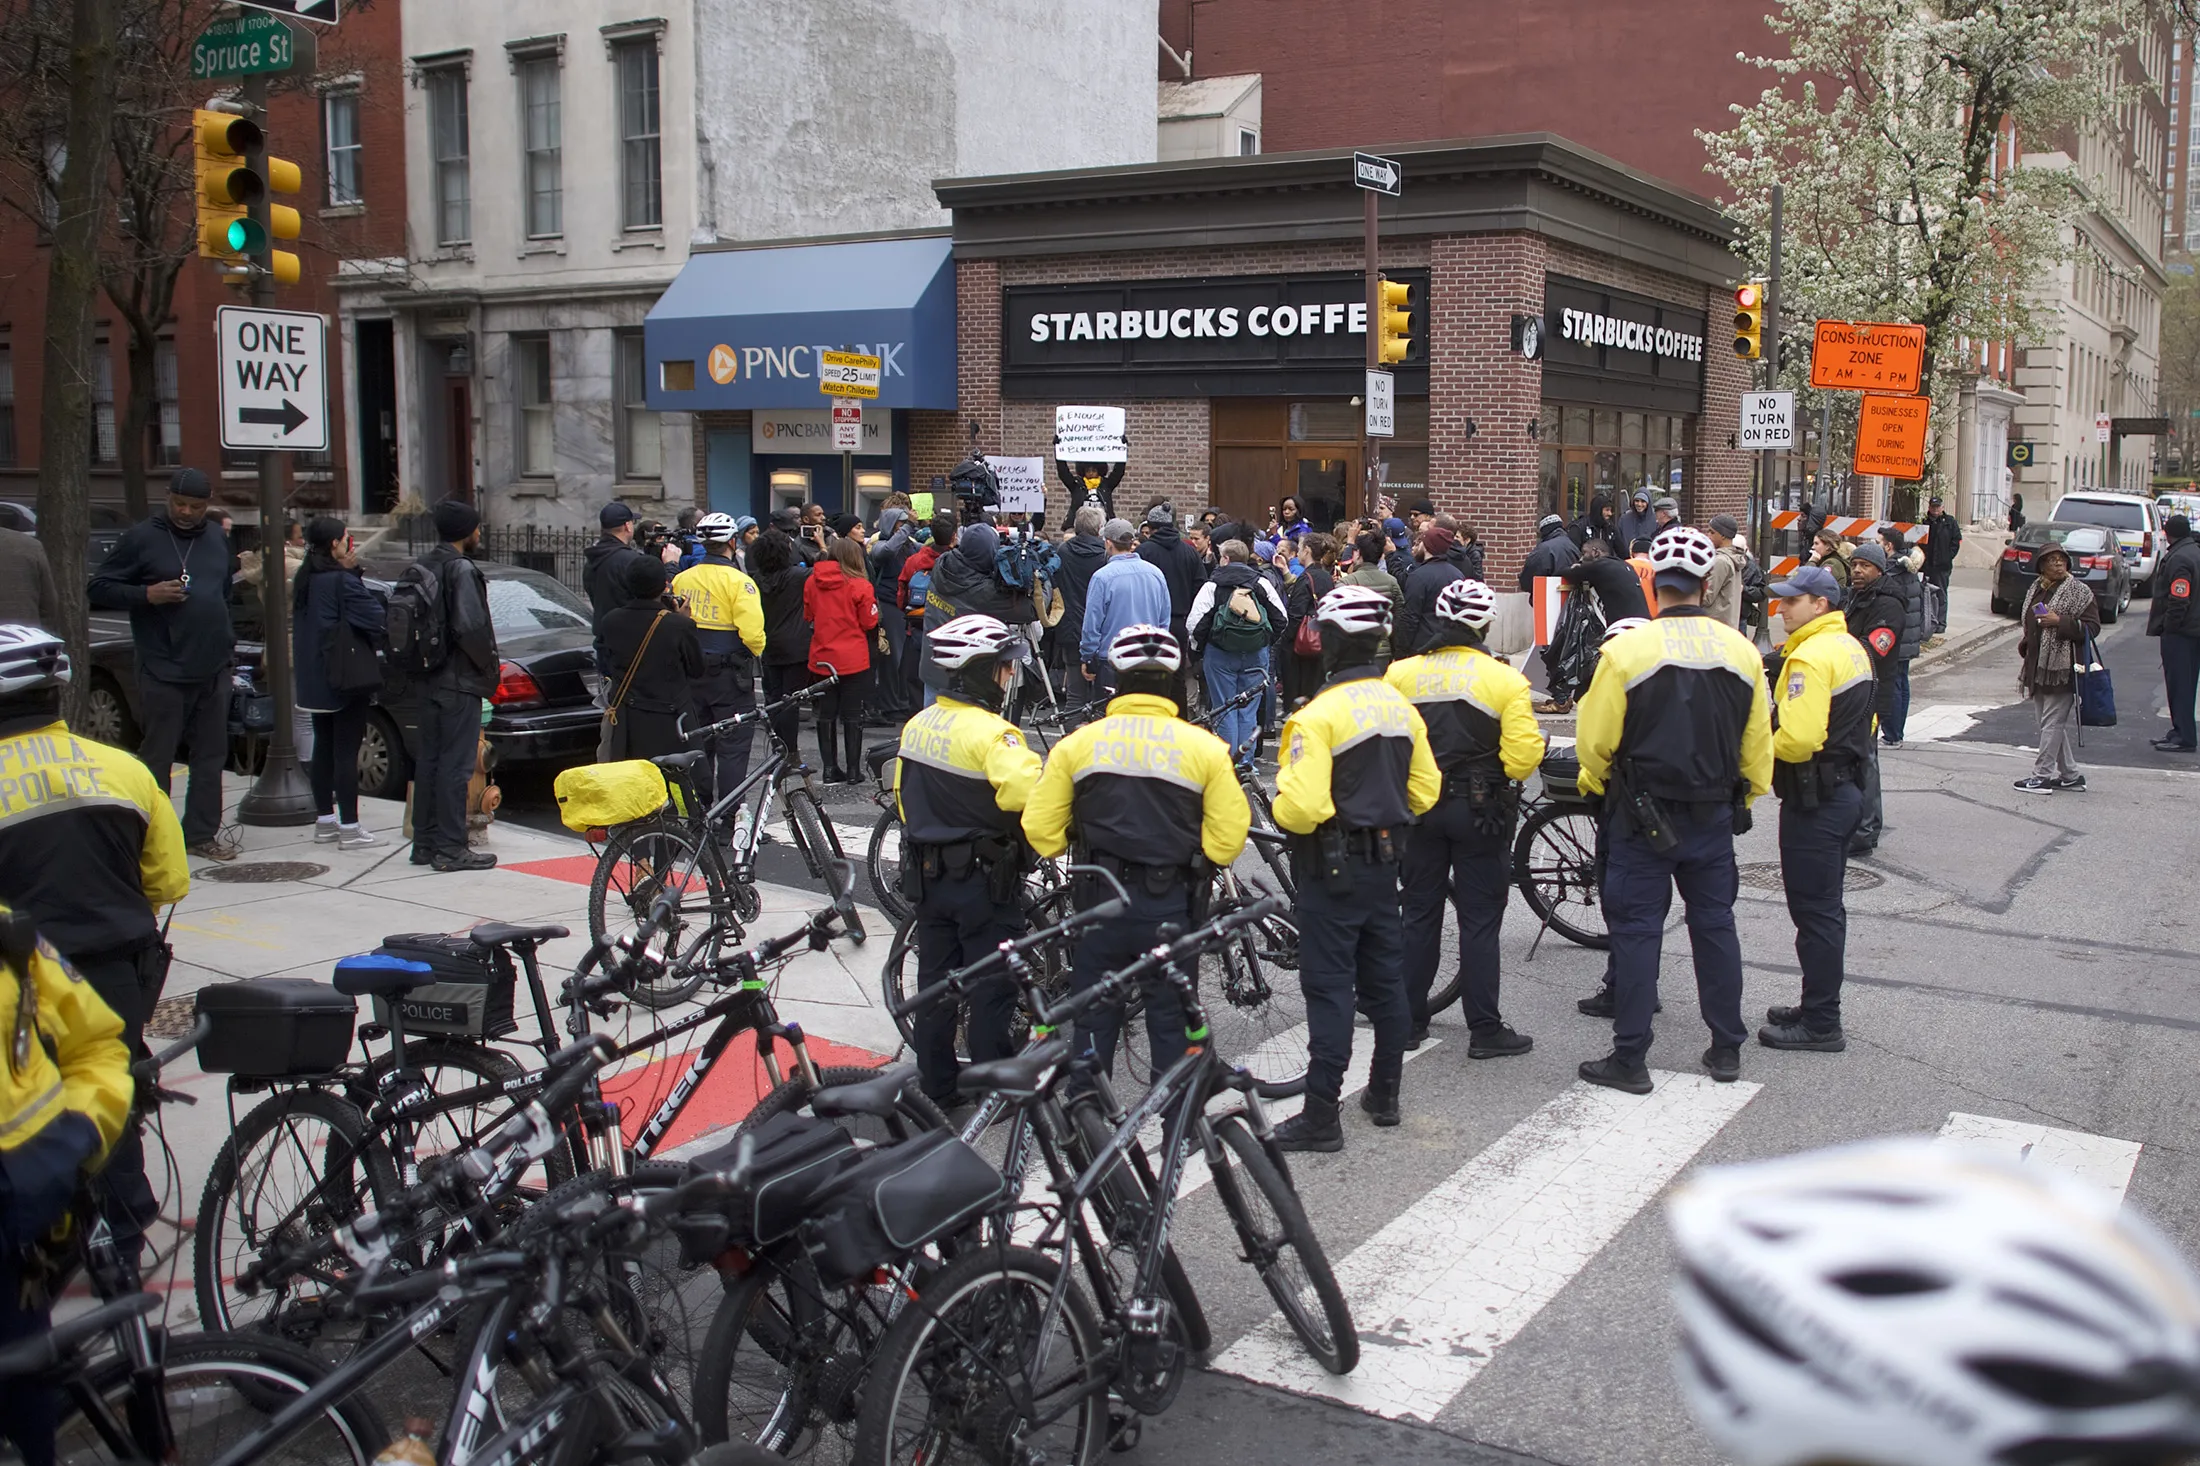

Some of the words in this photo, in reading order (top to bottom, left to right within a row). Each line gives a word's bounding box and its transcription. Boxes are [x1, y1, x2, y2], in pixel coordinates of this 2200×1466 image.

[213, 23, 234, 35] 1800
[235, 19, 246, 34] W
[248, 17, 269, 30] 1700
[194, 42, 261, 77] Spruce
[269, 35, 288, 63] St
[1360, 164, 1373, 178] ONE
[1375, 168, 1387, 182] WAY
[1030, 307, 1239, 342] STARBUCKS
[1248, 303, 1367, 337] COFFE
[238, 322, 306, 355] ONE
[1562, 307, 1654, 354] STARBUCKS
[1655, 328, 1703, 362] COFFEE
[1821, 330, 1918, 349] CONSTRUCTION
[826, 354, 843, 364] Drive
[844, 356, 877, 368] CarePhilly
[1849, 351, 1884, 365] ZONE
[236, 360, 308, 392] WAY
[824, 368, 841, 378] SPEED
[842, 367, 858, 382] 25
[860, 371, 876, 382] LIMIT
[1822, 367, 1829, 377] 7
[1836, 369, 1853, 380] AM
[1874, 371, 1882, 380] 4
[1890, 373, 1907, 383] PM
[823, 382, 844, 393] Watch
[846, 384, 876, 396] Children
[1375, 380, 1385, 392] NO
[1373, 397, 1388, 409] TURN
[1758, 398, 1776, 409] NO
[841, 409, 852, 417] NO
[1750, 413, 1785, 425] TURN
[1871, 406, 1918, 418] BUSINESSES
[1369, 415, 1378, 426] ON
[1380, 416, 1391, 428] RED
[1882, 423, 1903, 433] OPEN
[862, 424, 878, 437] TM
[1744, 429, 1760, 440] ON
[1765, 429, 1790, 440] RED
[1876, 439, 1905, 449] DURING
[1860, 454, 1918, 467] CONSTRUCTION
[994, 465, 1027, 474] NOUGH
[1002, 496, 1020, 505] LM
[1661, 618, 1717, 638] PHILA
[1665, 638, 1728, 661] POLICE
[1423, 653, 1478, 674] PHILA
[1416, 673, 1479, 697] POLICE
[1104, 717, 1176, 744] PHILA
[1094, 741, 1183, 773] POLICE
[0, 767, 110, 813] POLICE
[666, 1007, 707, 1031] POLICE
[503, 1071, 543, 1092] POLICE
[635, 1045, 712, 1156] TREK
[451, 1352, 499, 1466] EK
